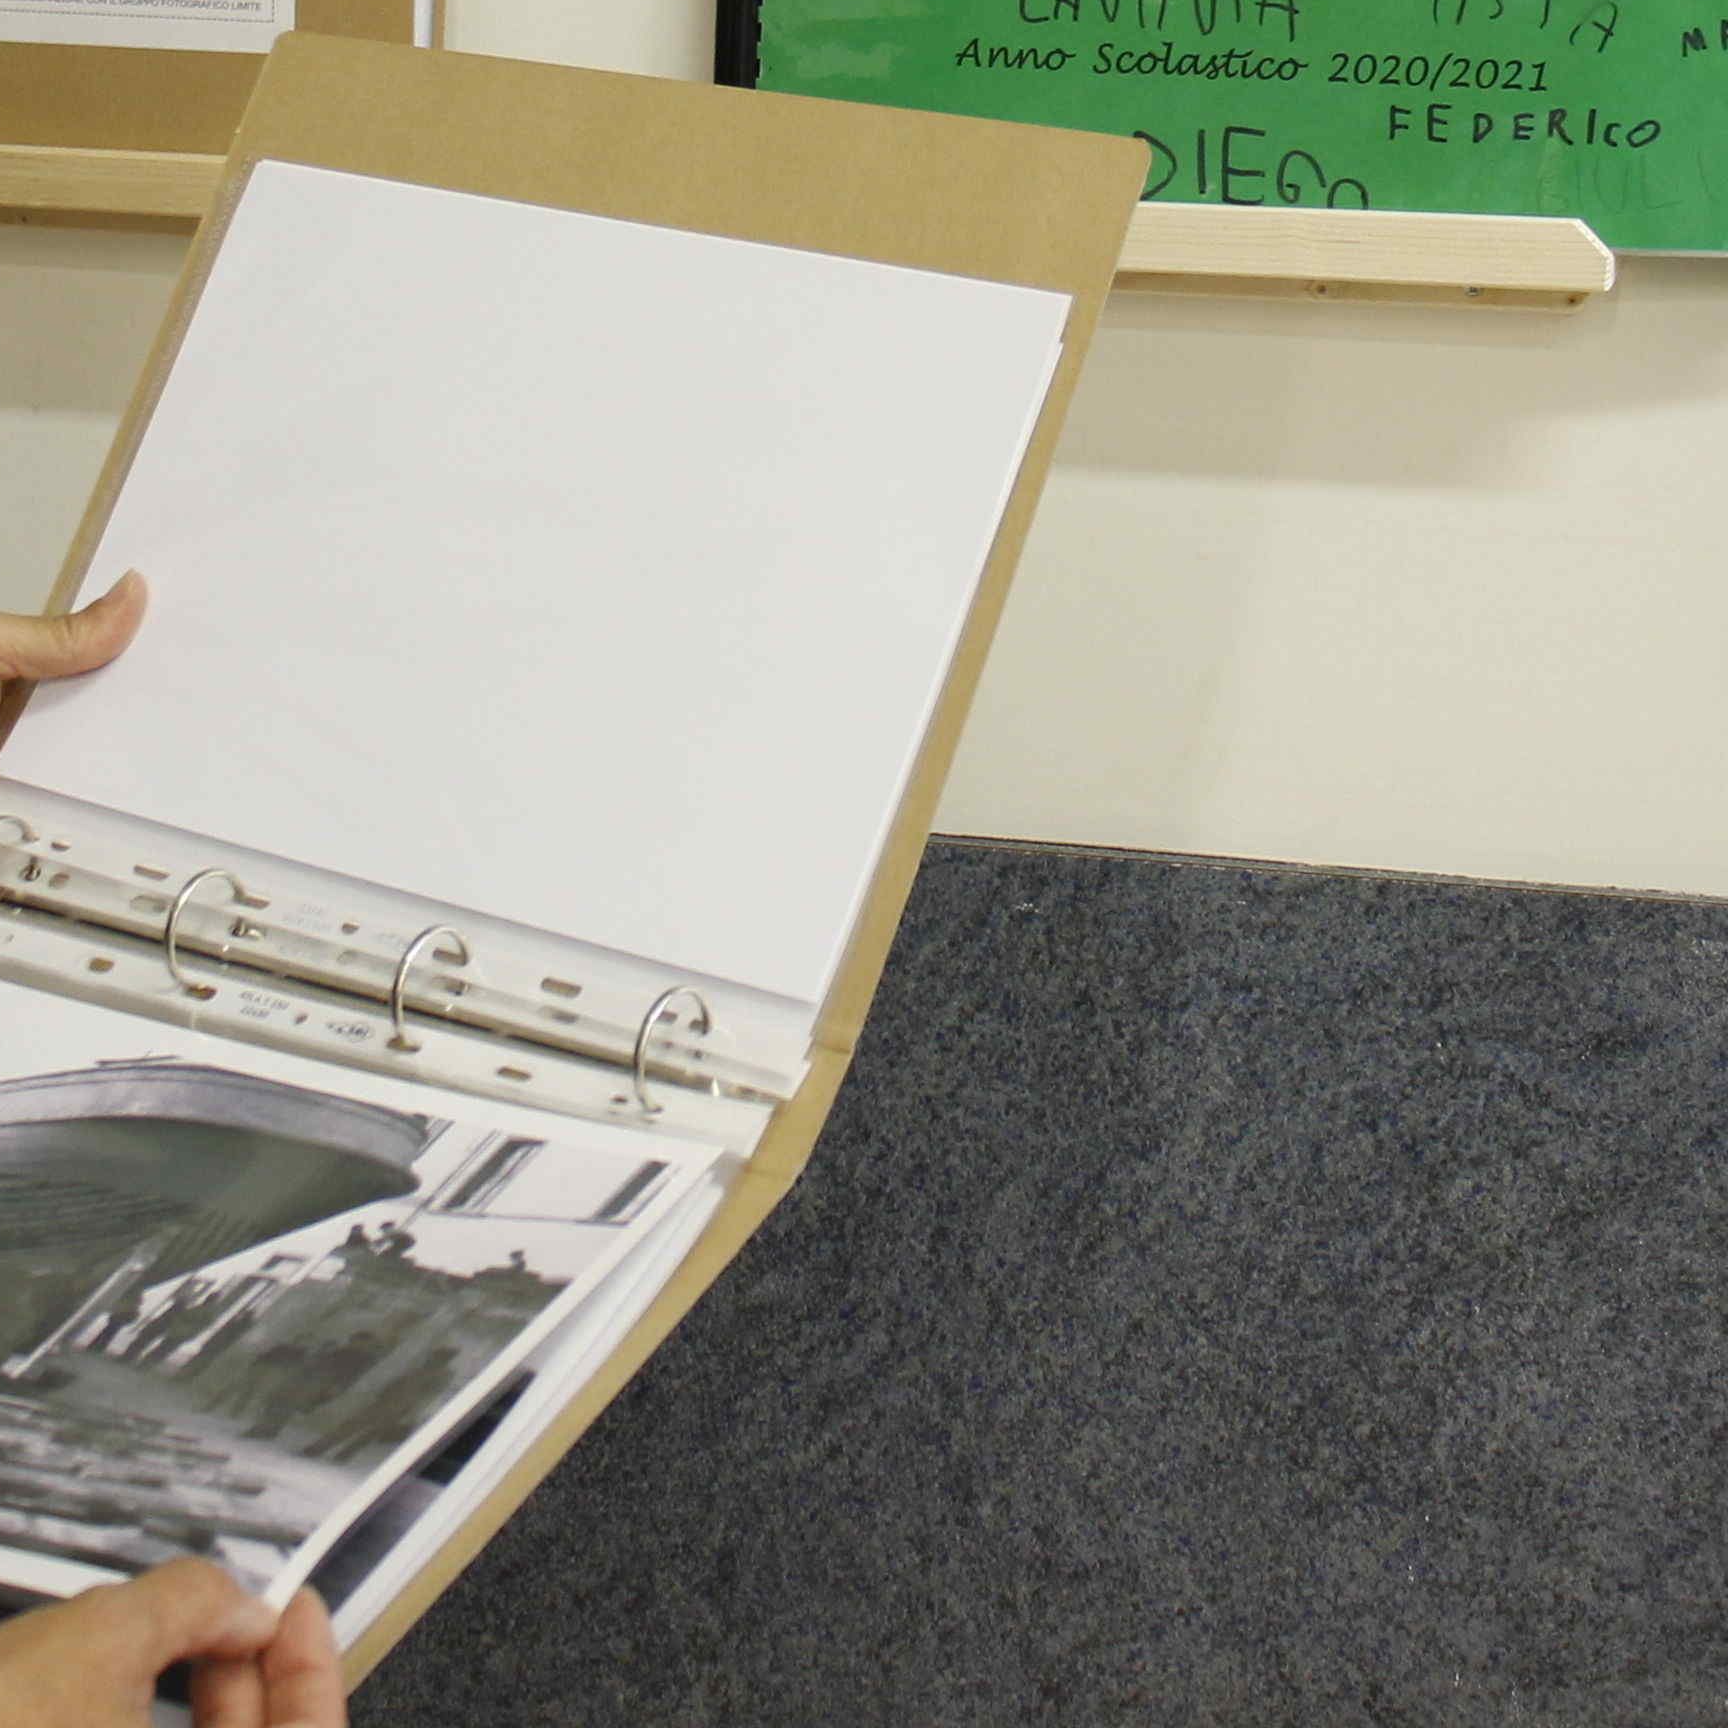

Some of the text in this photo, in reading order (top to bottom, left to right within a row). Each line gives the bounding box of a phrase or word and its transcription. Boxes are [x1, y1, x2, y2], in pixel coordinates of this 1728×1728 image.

[955, 39, 1549, 93] Anno Scolastico 2020/2021
[1390, 104, 1660, 148] FEDERICO
